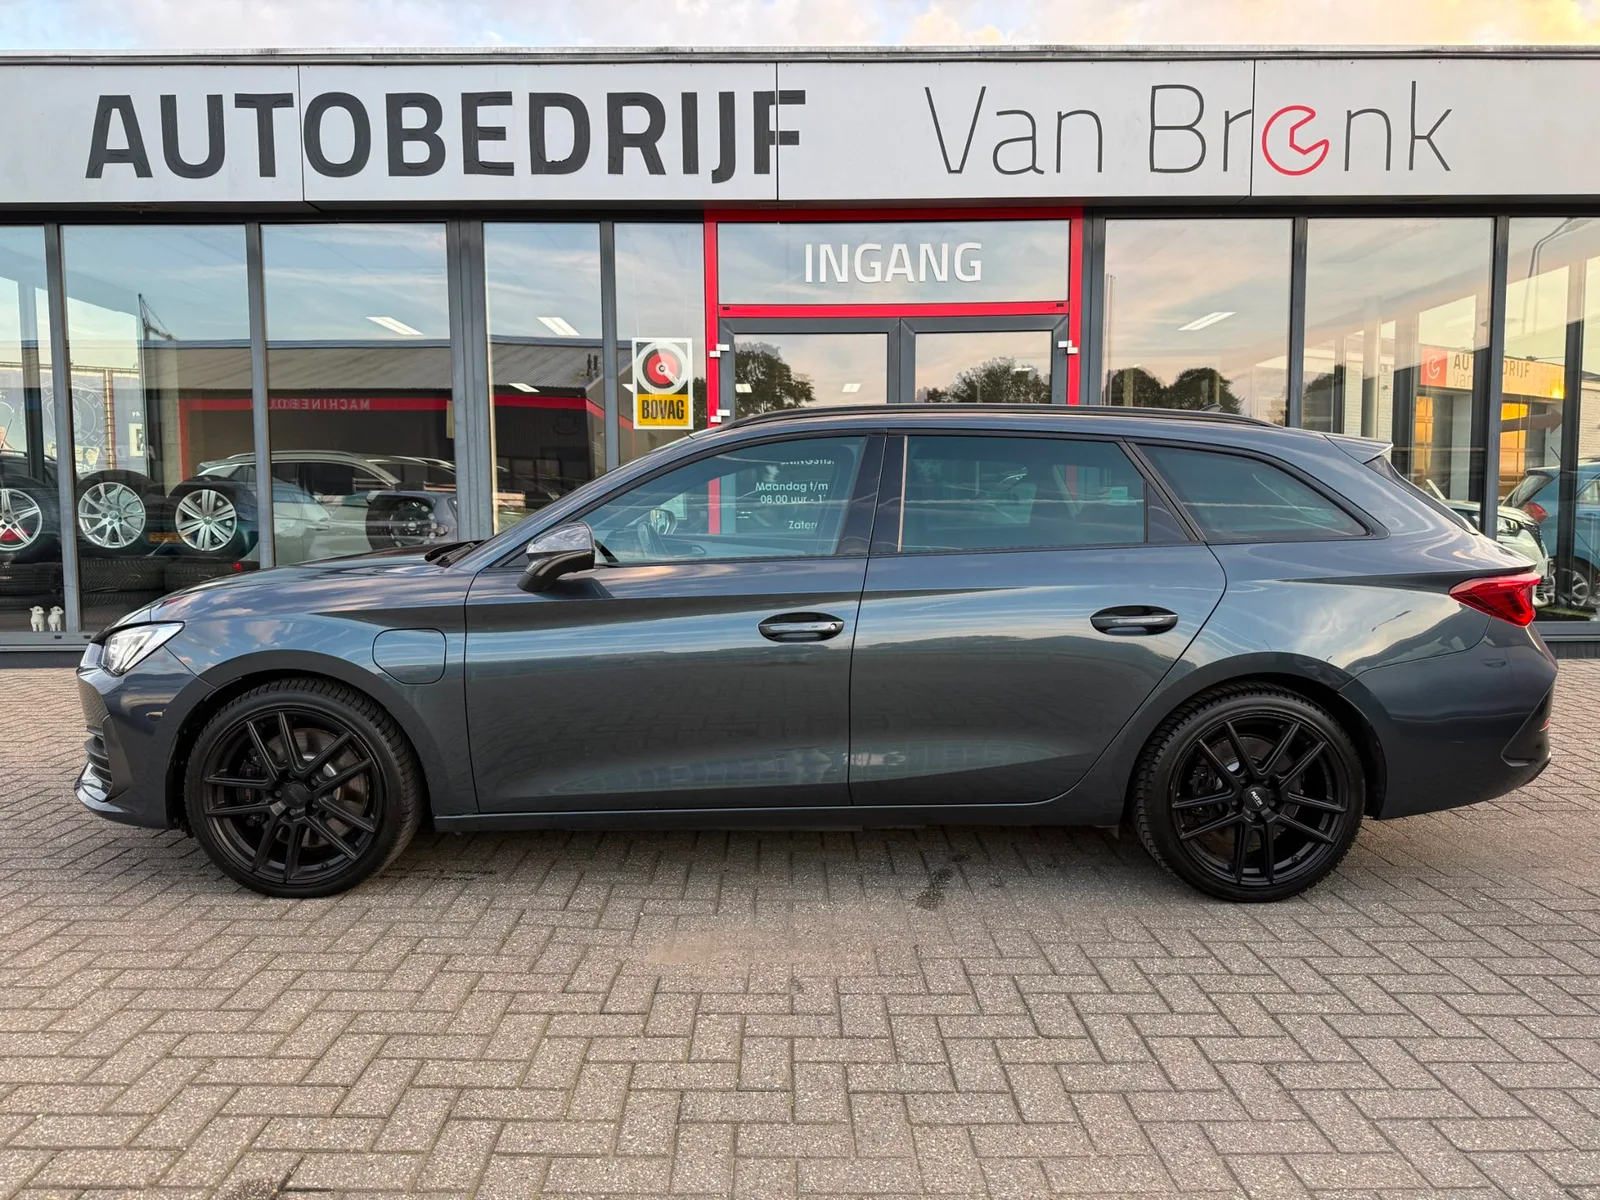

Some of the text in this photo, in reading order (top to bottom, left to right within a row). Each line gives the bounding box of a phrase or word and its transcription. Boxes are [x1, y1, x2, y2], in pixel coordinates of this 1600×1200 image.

[85, 91, 806, 184] AUTOBEDRIJF
[924, 85, 1103, 175] Van
[805, 242, 982, 283] INGANG
[641, 399, 685, 420] BOVAG
[755, 481, 828, 493] Maandag t/m
[760, 494, 788, 504] 08.00
[790, 496, 807, 504] uur
